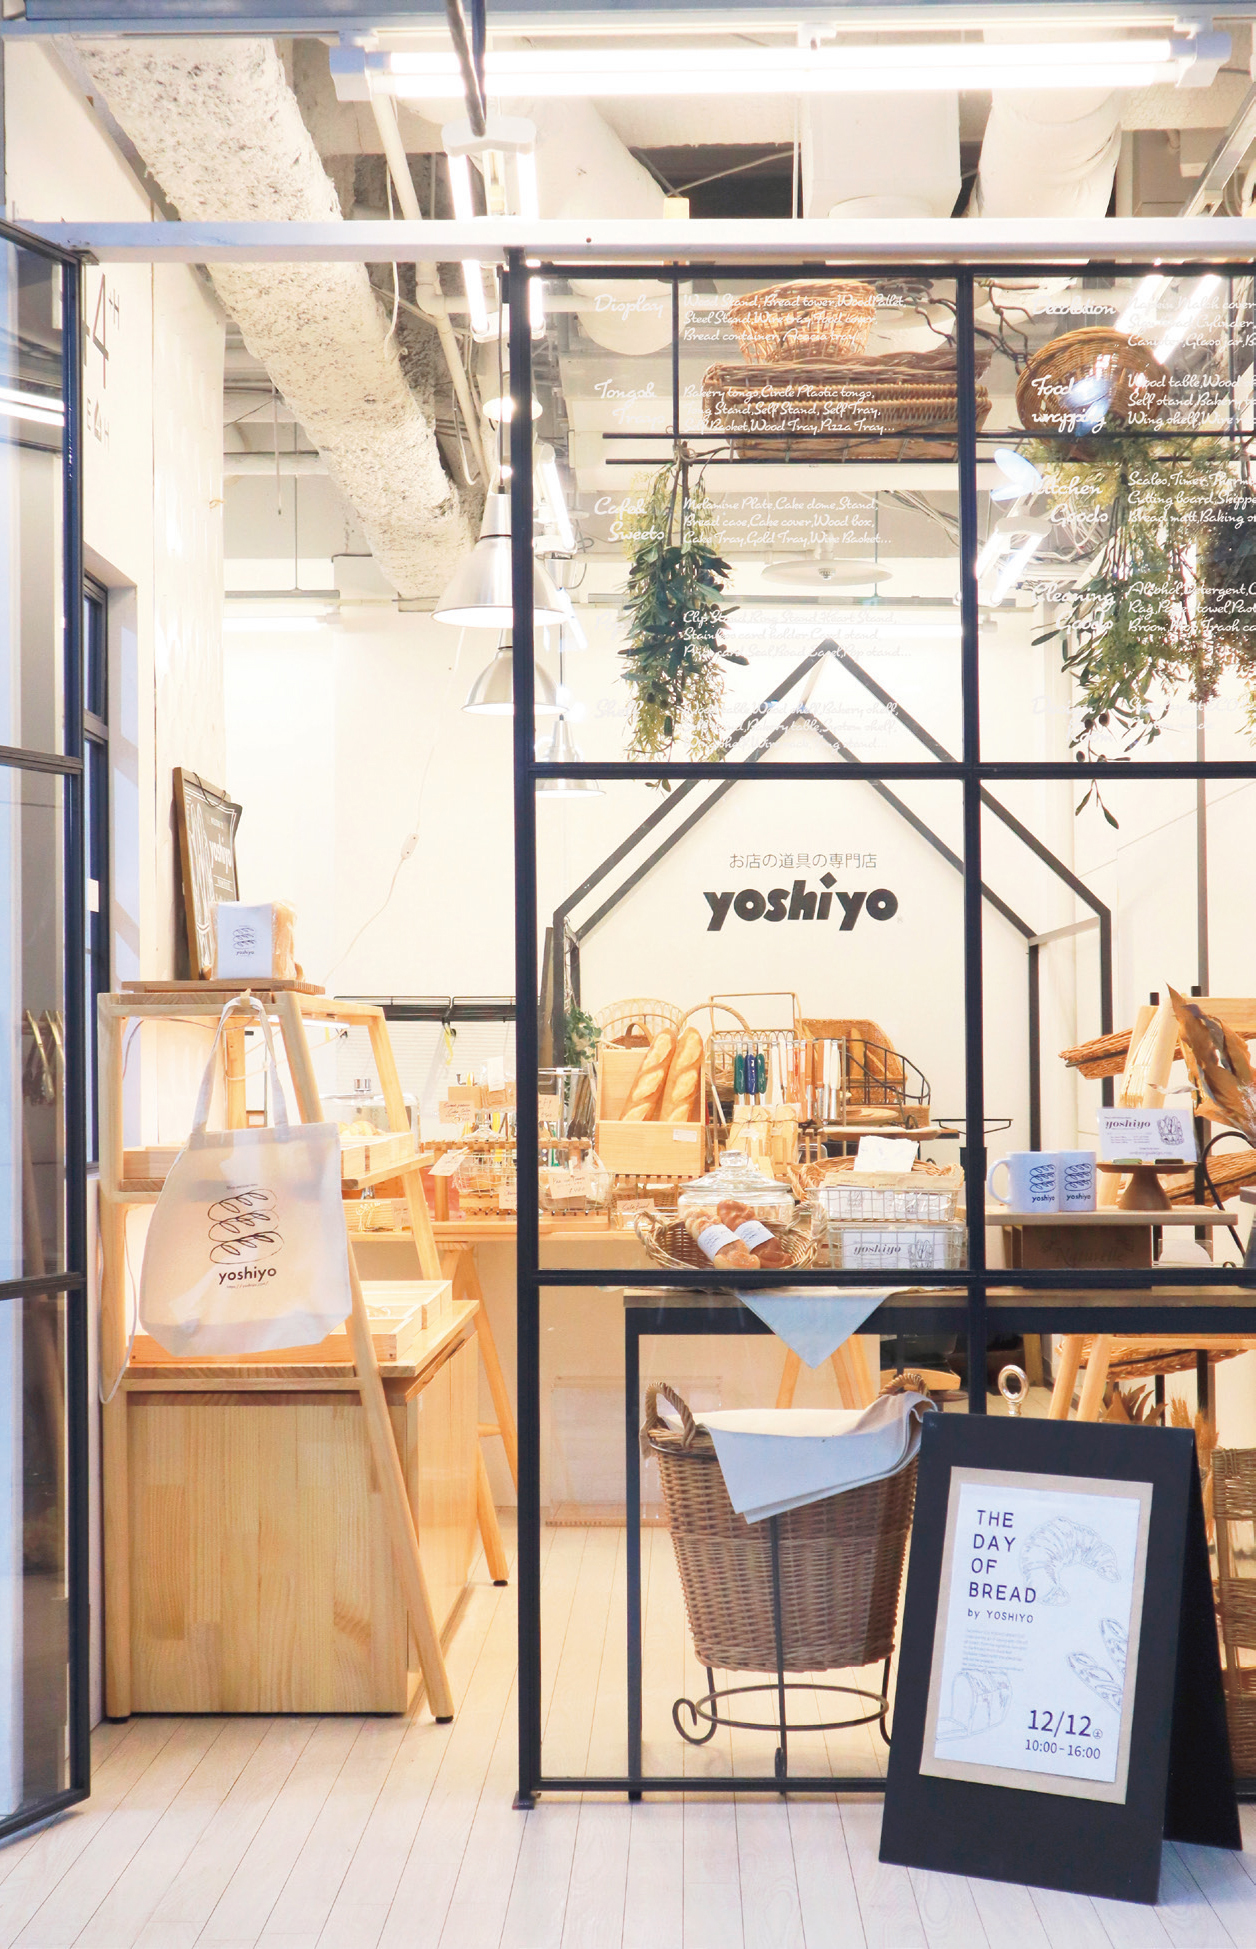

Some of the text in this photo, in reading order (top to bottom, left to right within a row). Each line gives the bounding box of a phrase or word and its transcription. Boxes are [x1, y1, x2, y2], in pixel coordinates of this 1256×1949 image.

[594, 294, 664, 321] Display
[764, 294, 801, 307] Bread
[684, 310, 713, 324] Steel
[684, 328, 719, 341] Bread
[796, 384, 839, 398] Plastic
[1031, 374, 1075, 396] Food
[822, 401, 847, 418] Self
[1127, 392, 1155, 410] Self
[1031, 408, 1107, 434] wrapping
[1127, 410, 1164, 432] Wing
[1031, 474, 1103, 495] Kitchen
[1127, 490, 1174, 511] Cutting
[683, 513, 719, 527] Bread
[1050, 503, 1109, 528] Goods
[1127, 508, 1168, 523] Bread
[607, 521, 665, 542] Sweets
[683, 531, 712, 544] Cake
[1031, 582, 1116, 611] Cleaning
[683, 610, 707, 628] Clip
[729, 853, 877, 869] お店の道具の専門店
[703, 871, 898, 931] yoshiyo
[1105, 1119, 1151, 1129] yoshiyo
[1031, 1194, 1055, 1203] yoshiyo
[1066, 1193, 1092, 1201] yoshiyo
[218, 1265, 277, 1285] yoshiyo
[977, 1509, 1014, 1528] THE
[973, 1533, 1016, 1552] DAY
[971, 1557, 998, 1574] OF
[969, 1581, 1036, 1603] BREAD
[967, 1608, 1034, 1623] by YOSHIYO
[1028, 1709, 1091, 1738] 12/12
